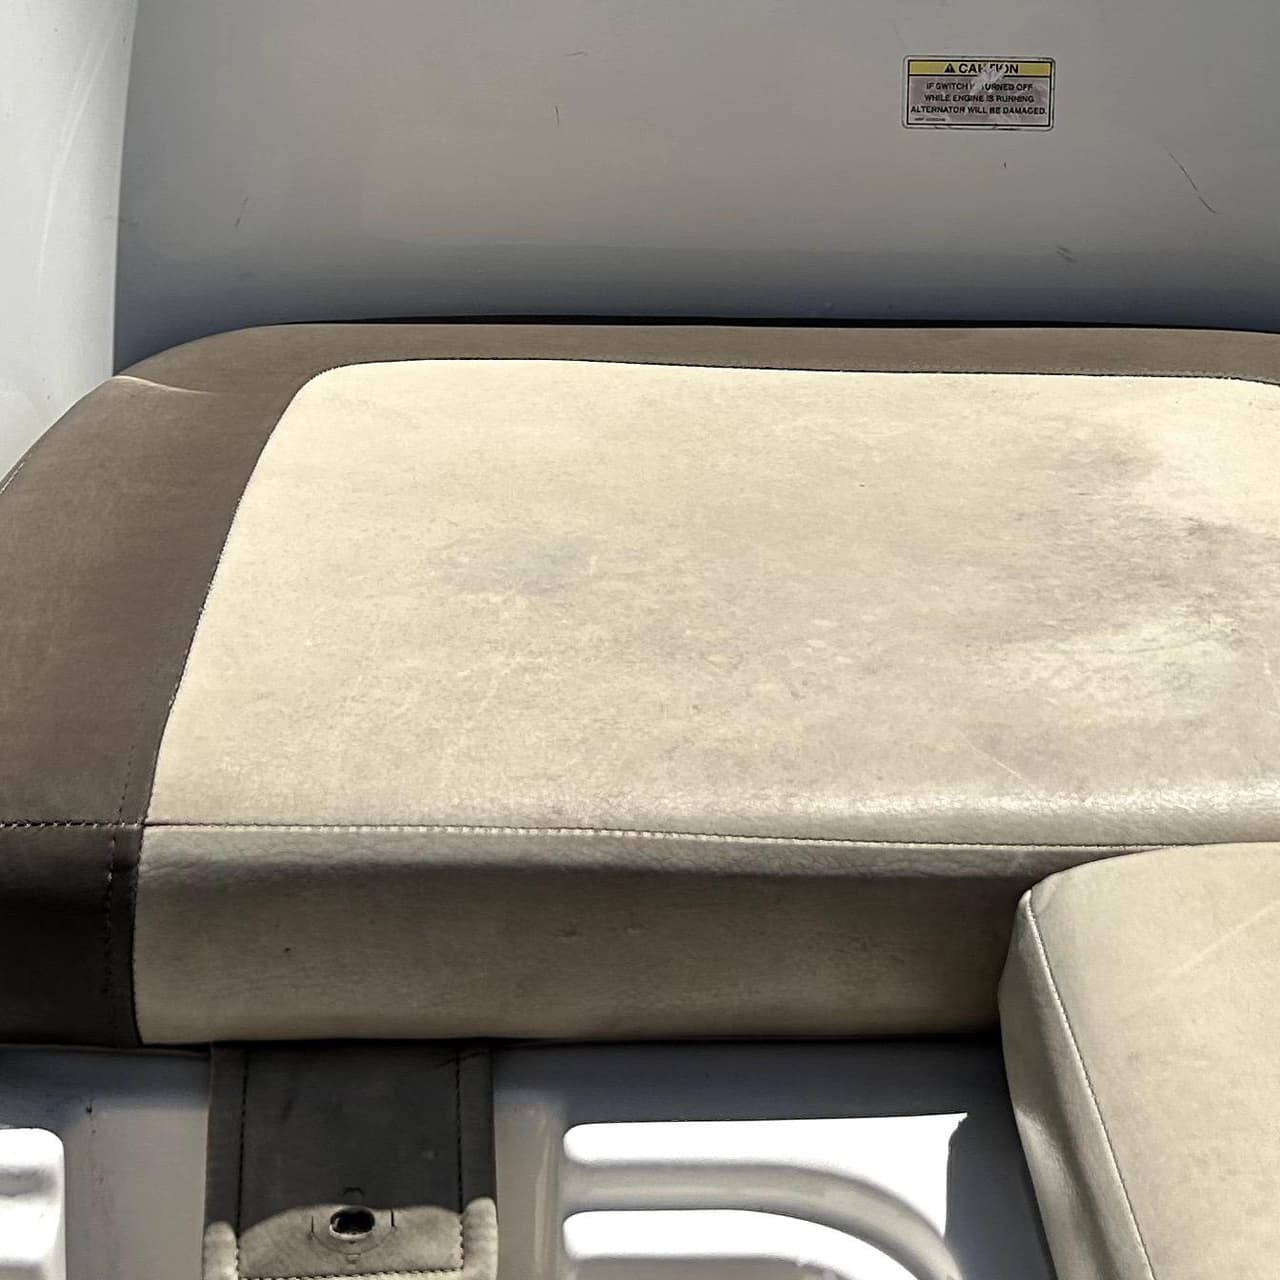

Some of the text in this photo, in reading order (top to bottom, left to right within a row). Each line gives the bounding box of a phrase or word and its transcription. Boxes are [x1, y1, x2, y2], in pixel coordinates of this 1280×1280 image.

[927, 82, 935, 90] IF
[982, 83, 1014, 91] URNED
[997, 95, 1034, 103] RUNNING
